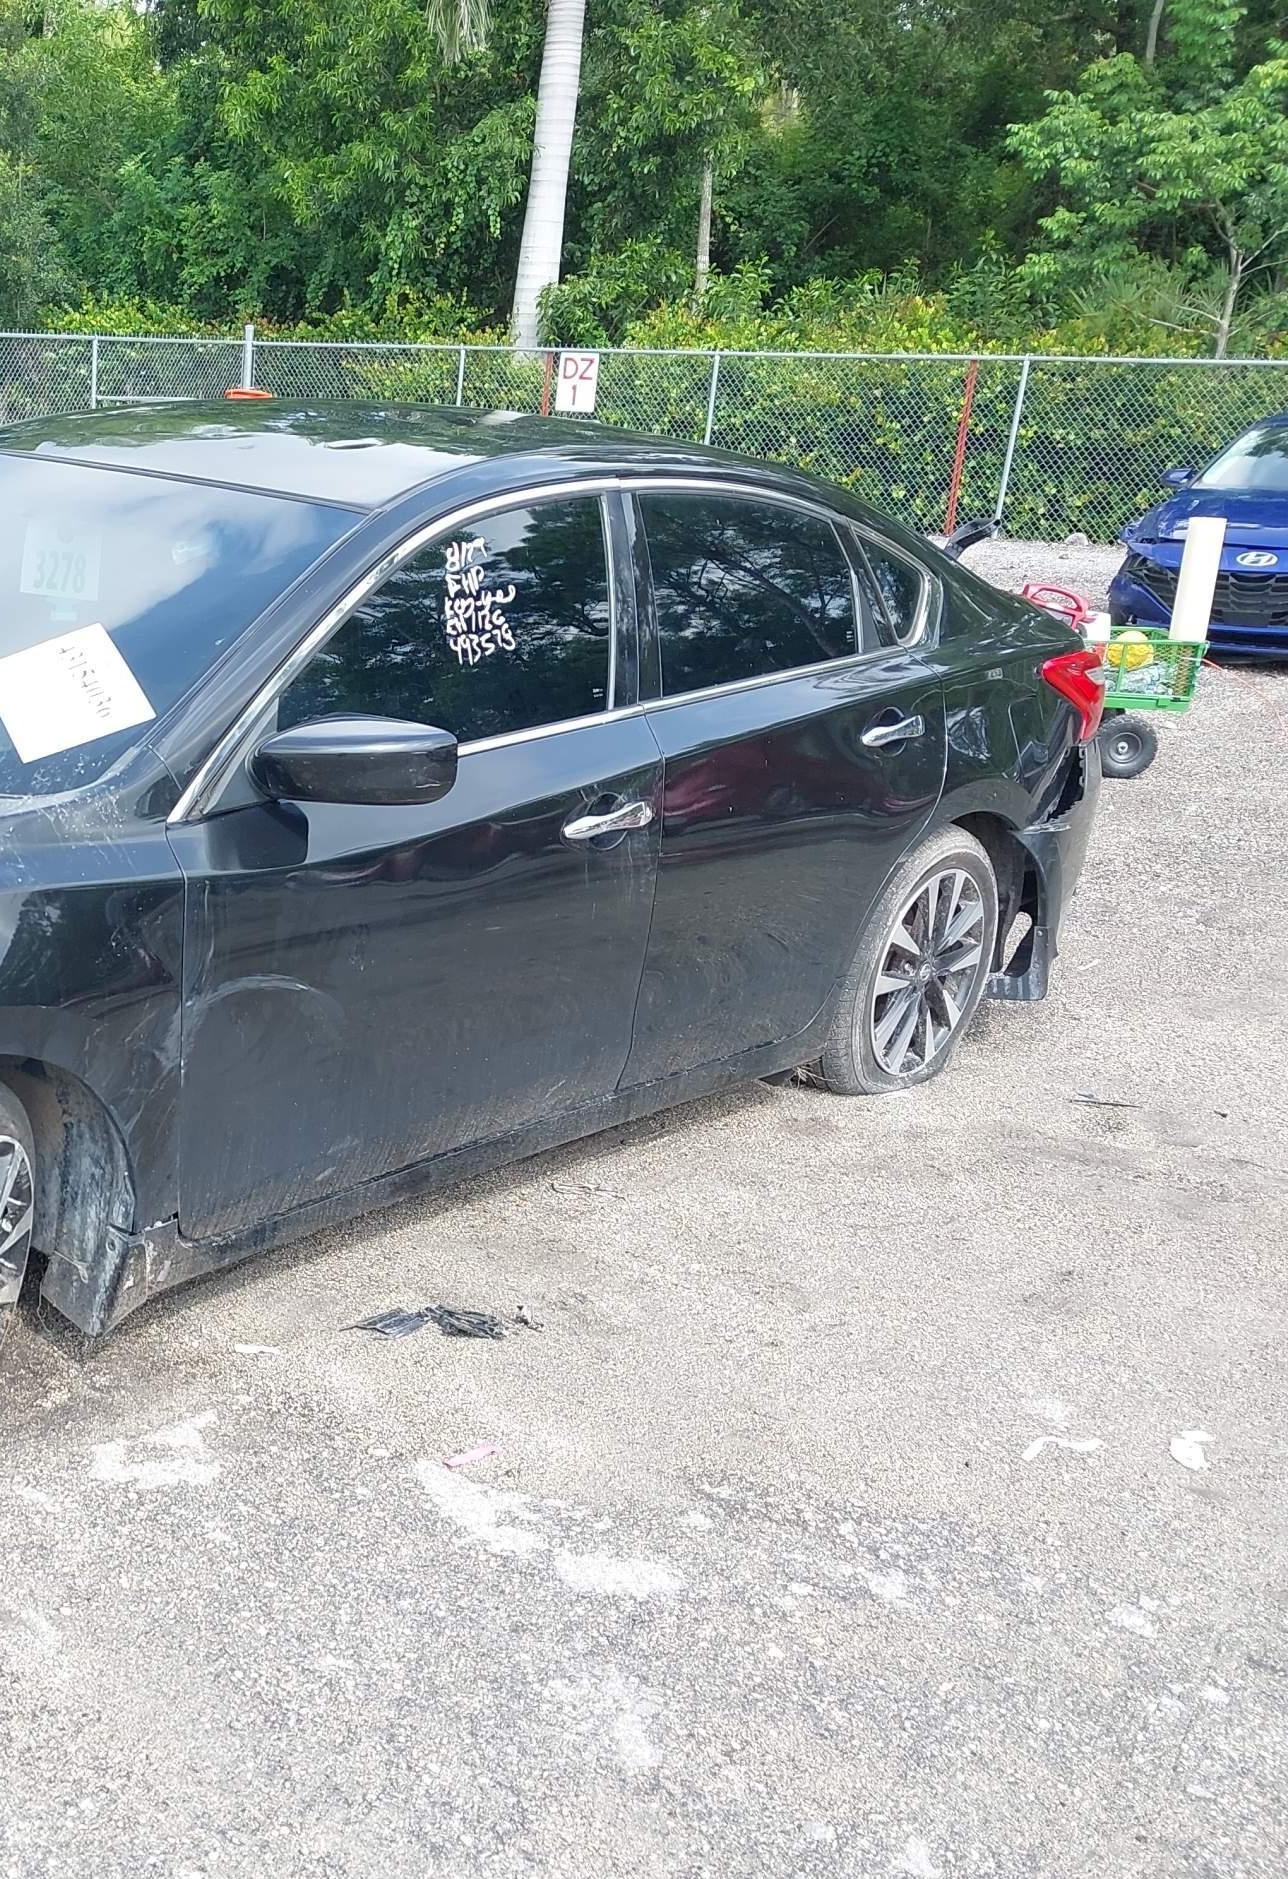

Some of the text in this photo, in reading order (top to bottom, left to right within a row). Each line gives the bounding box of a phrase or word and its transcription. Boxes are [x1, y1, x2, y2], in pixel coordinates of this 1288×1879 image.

[562, 357, 595, 380] DZ
[571, 384, 578, 406] 1
[32, 550, 87, 594] 3278
